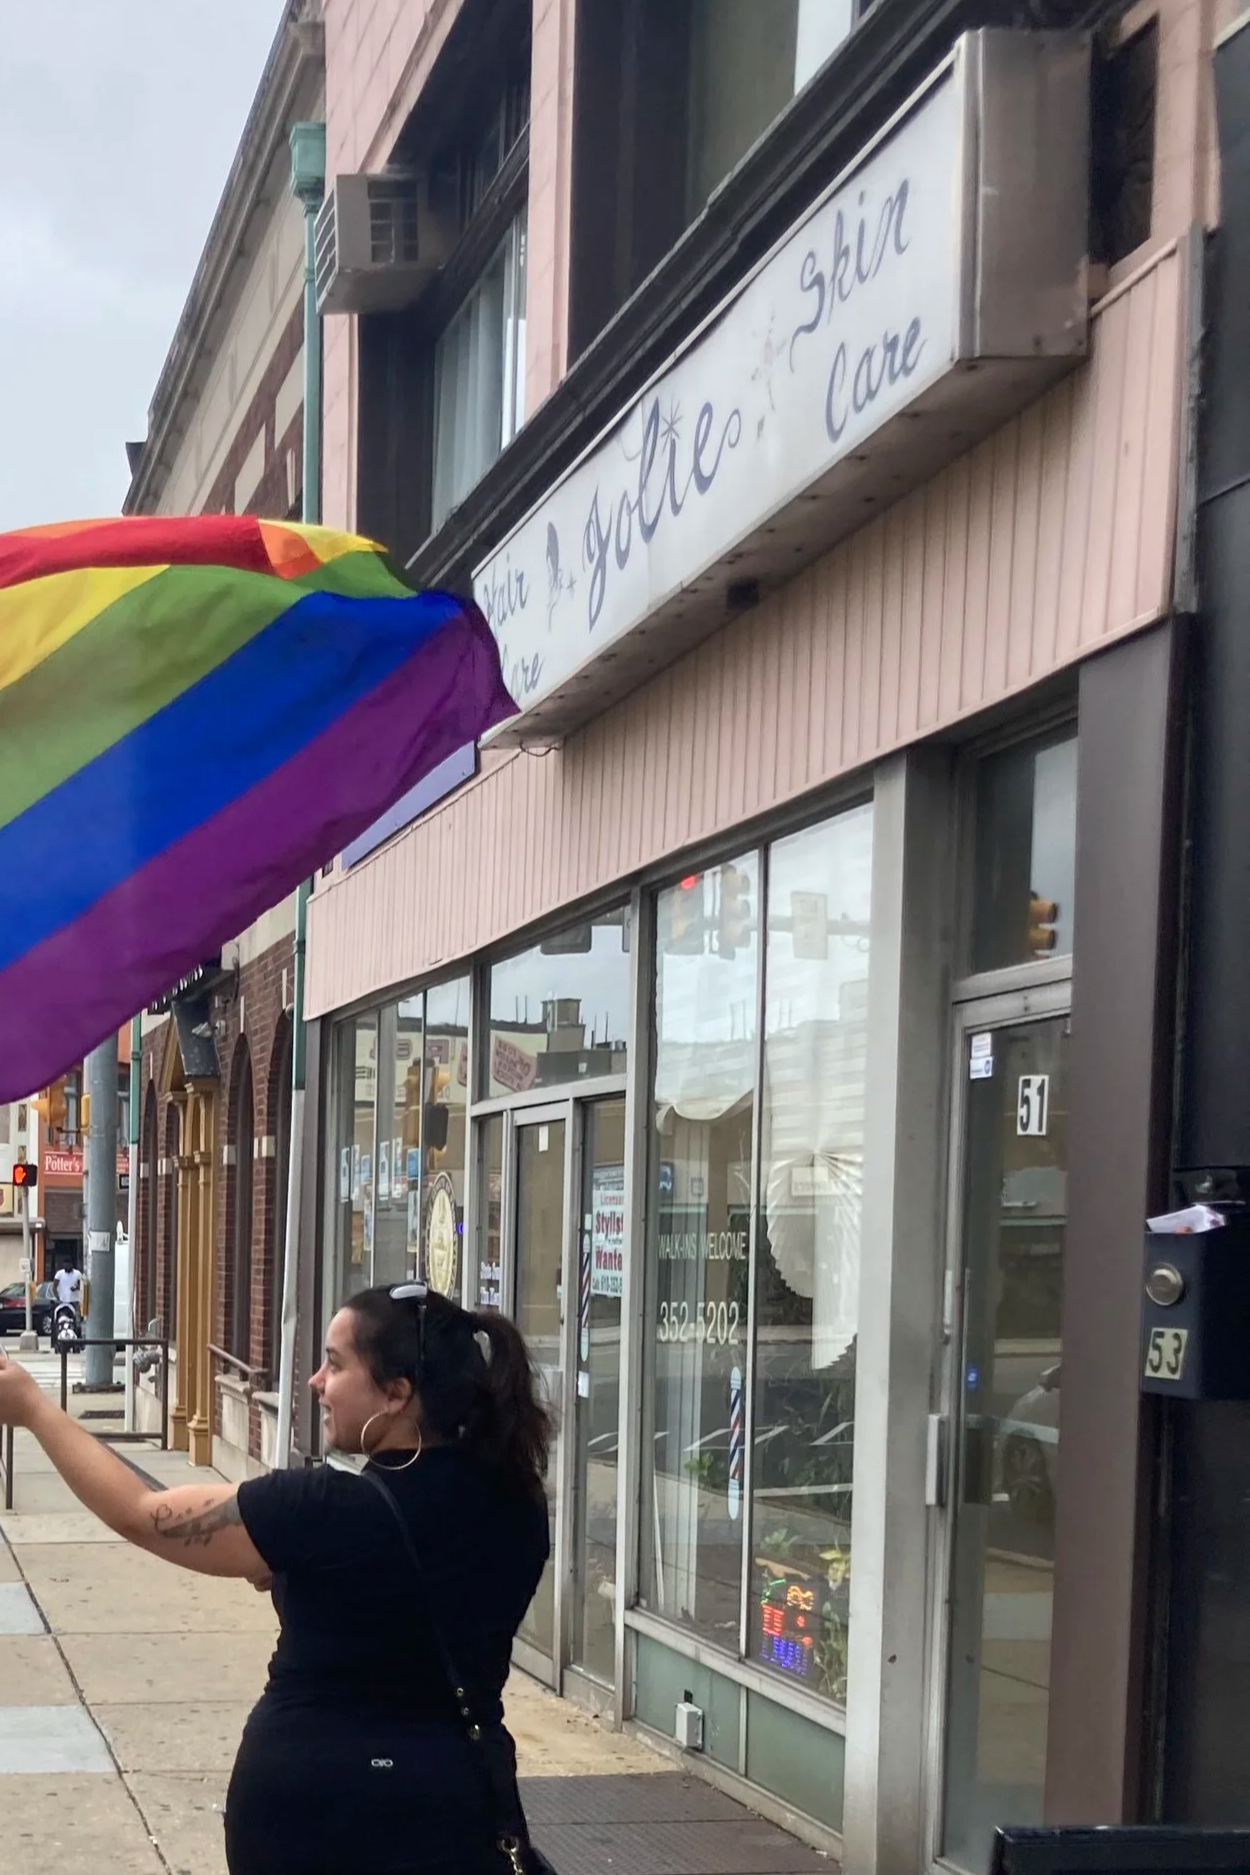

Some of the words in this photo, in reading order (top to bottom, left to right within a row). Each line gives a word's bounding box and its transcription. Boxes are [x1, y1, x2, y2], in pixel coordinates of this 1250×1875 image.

[789, 178, 915, 373] Skin
[825, 316, 929, 444] Care
[1019, 1078, 1046, 1132] 51
[595, 1246, 622, 1271] Wante
[658, 1233, 697, 1260] WALK-INS
[701, 1231, 748, 1260] WELCOME
[658, 1301, 740, 1345] 352-5202
[1148, 1330, 1183, 1375] 53
